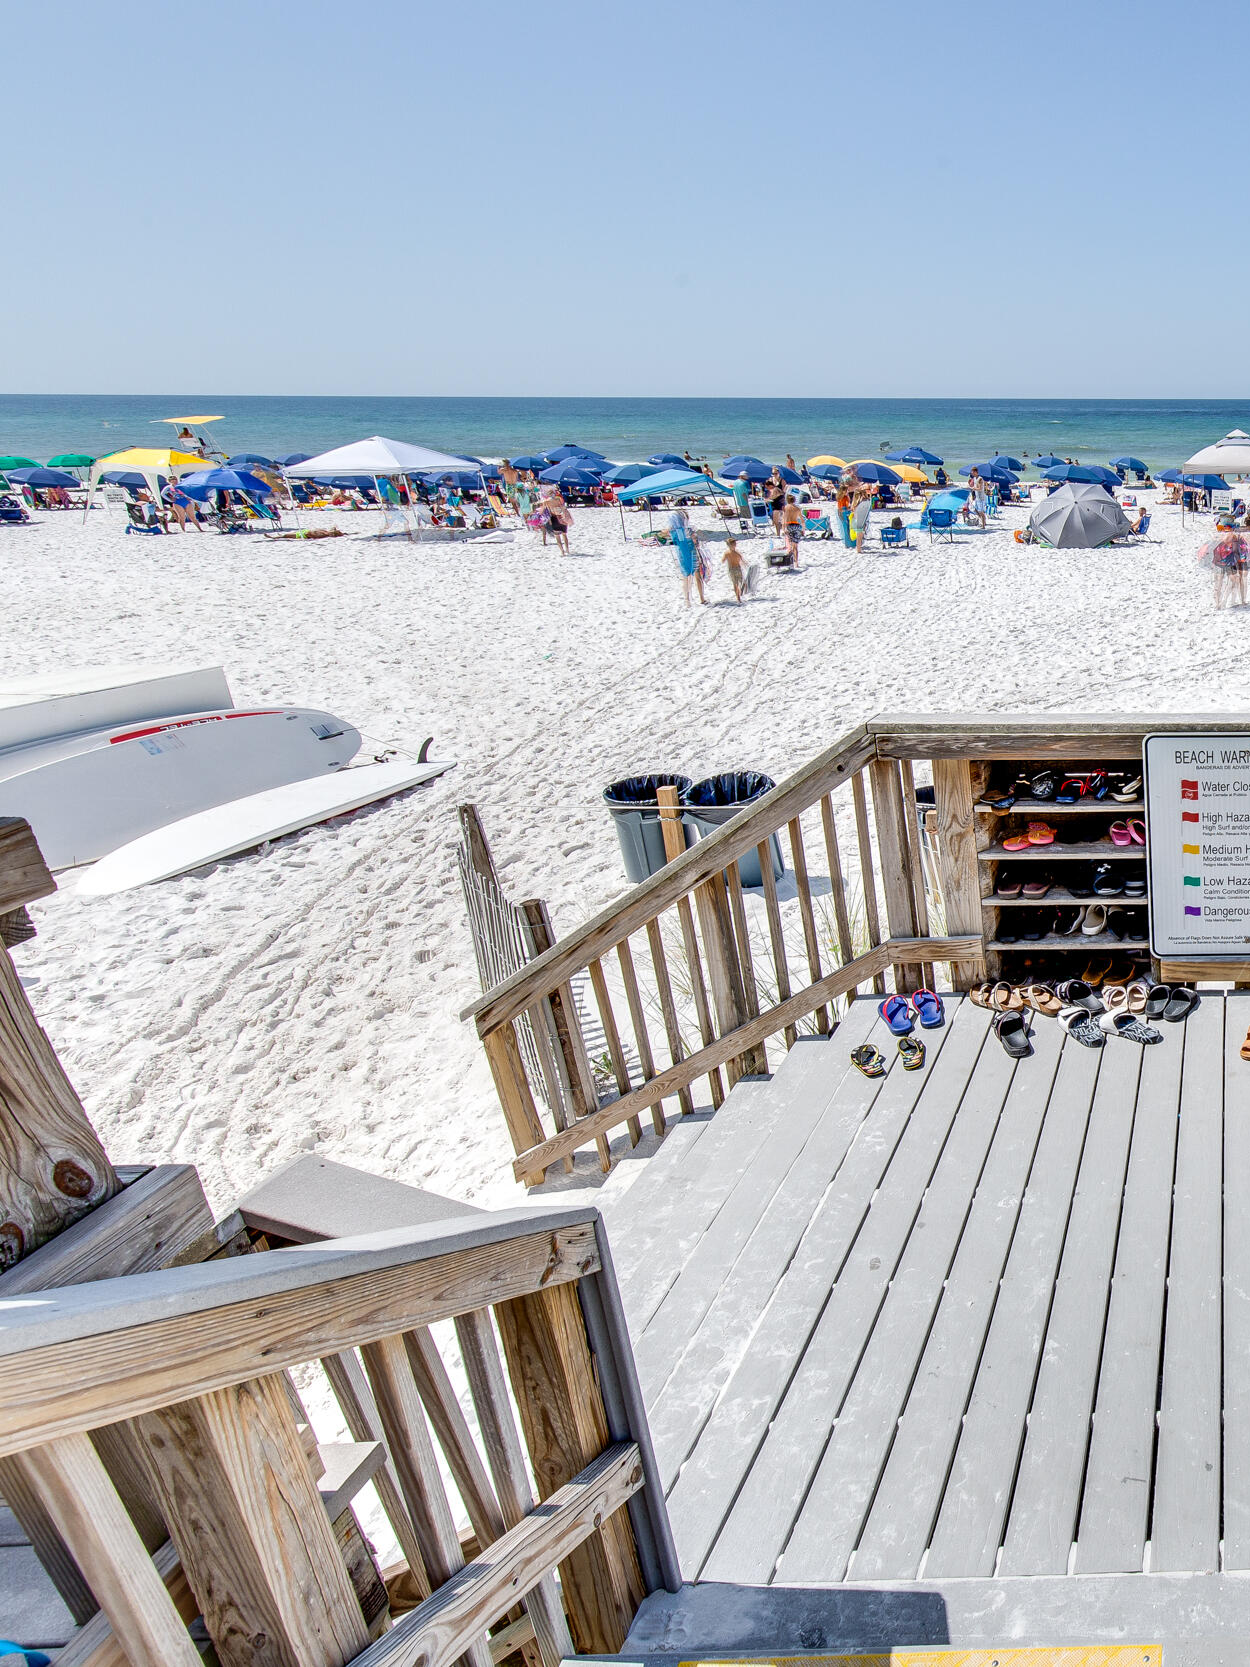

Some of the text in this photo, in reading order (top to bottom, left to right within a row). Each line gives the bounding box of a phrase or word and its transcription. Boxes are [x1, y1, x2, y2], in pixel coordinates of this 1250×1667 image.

[1175, 750, 1214, 764] BEACH
[1202, 781, 1230, 792] Water
[1202, 812, 1223, 824] High
[1202, 844, 1242, 854] Medium
[1203, 877, 1224, 886] Low
